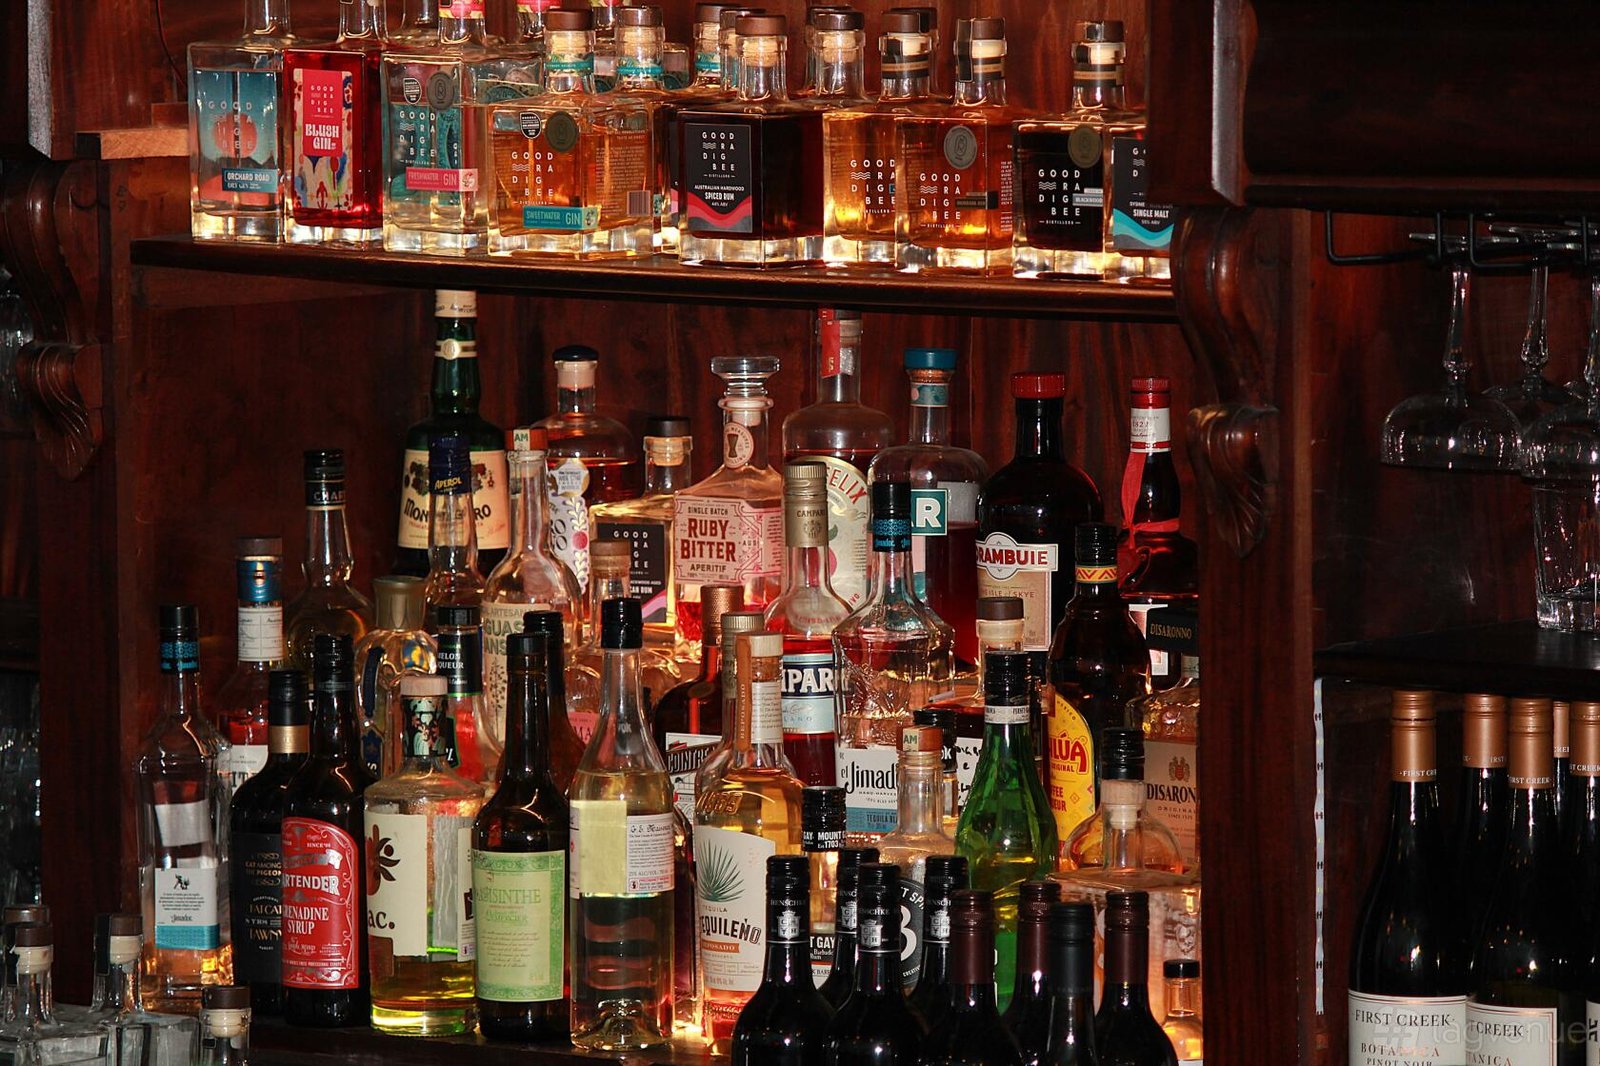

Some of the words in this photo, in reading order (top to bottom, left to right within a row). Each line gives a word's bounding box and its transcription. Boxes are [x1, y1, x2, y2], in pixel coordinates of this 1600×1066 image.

[399, 110, 436, 121] GOOD
[305, 123, 339, 138] BLUSH
[702, 131, 734, 140] GOOD
[313, 137, 331, 150] GIN
[720, 143, 735, 151] RA
[511, 152, 554, 160] GOOD
[703, 152, 726, 160] DIG
[535, 164, 554, 173] RA
[712, 163, 735, 171] BEE
[850, 159, 895, 168] GOOD
[227, 172, 253, 181] ORCHARD
[254, 173, 270, 181] ROAD
[919, 173, 961, 182] GOOD
[1038, 169, 1081, 178] GOOD
[443, 173, 458, 186] GIN
[512, 175, 542, 184] DIG
[943, 186, 961, 195] RA
[1062, 182, 1081, 191] RA
[525, 188, 554, 197] BEE
[705, 191, 722, 200] SPICED
[723, 192, 735, 201] RUM
[920, 198, 950, 207] DIG
[1039, 194, 1069, 203] DIG
[932, 211, 961, 220] BEE
[1051, 207, 1081, 216] BEE
[1133, 209, 1153, 218] SINGLE
[1154, 209, 1170, 218] MALT
[526, 210, 560, 221] SWEETWATER
[565, 212, 580, 226] GIN
[434, 477, 463, 491] APEROL
[826, 466, 867, 505] ELIX
[688, 506, 708, 515] SINGLE
[710, 507, 728, 516] BATCH
[687, 518, 729, 540] RUBY
[613, 530, 649, 539] GOOD
[680, 539, 736, 563] BITTER
[976, 547, 1048, 566] RAMBUIE
[690, 563, 727, 573] APERITIF
[1150, 622, 1192, 640] DISARONNO
[438, 661, 465, 670] QUEUR
[903, 733, 918, 745] AM
[840, 765, 849, 779] el
[1403, 769, 1425, 777] FIRST
[844, 760, 898, 795] Jimad
[1147, 782, 1196, 804] DISARON
[817, 830, 842, 841] MOUNT
[825, 840, 839, 849] 1703
[283, 904, 329, 921] RENADINE
[287, 920, 316, 935] SYRUP
[816, 936, 835, 949] GAY
[1354, 1009, 1392, 1027] FIRST
[1396, 1013, 1451, 1028] CREEK
[1476, 1021, 1525, 1037] CREEK
[1360, 1042, 1441, 1058] BOTANICA
